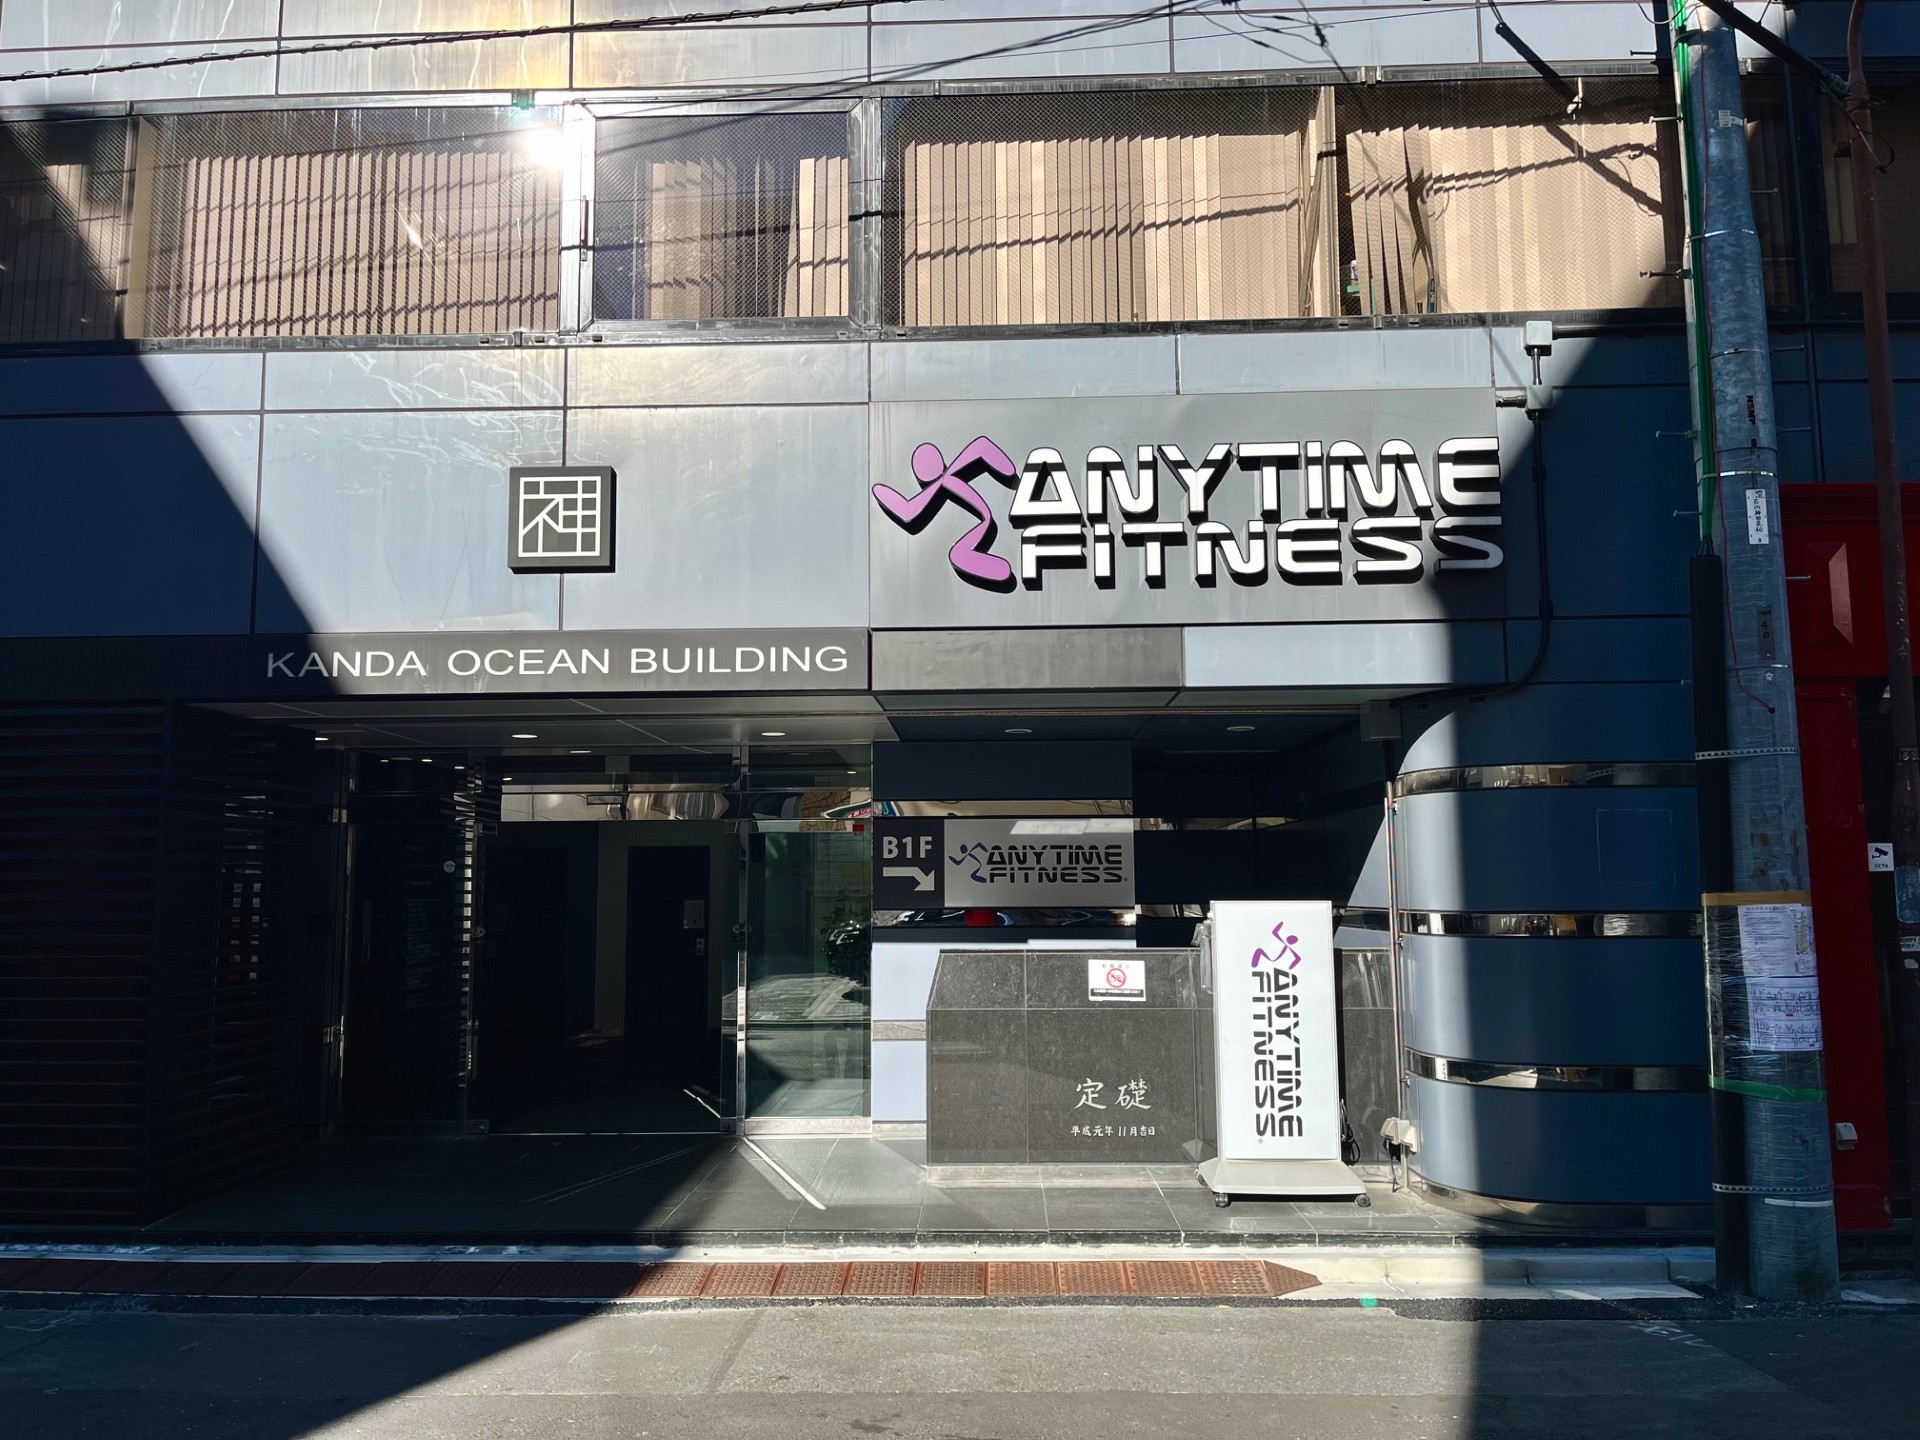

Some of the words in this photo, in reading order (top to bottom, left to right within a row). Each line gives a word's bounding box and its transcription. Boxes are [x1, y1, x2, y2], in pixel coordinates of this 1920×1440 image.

[1009, 437, 1501, 518] ANYTIME
[1021, 516, 1504, 586] FITNESS
[266, 650, 428, 678] KANDA
[447, 648, 610, 676] OCEAN
[630, 646, 849, 674] BUILDING
[882, 836, 933, 859] B1F
[986, 844, 1123, 866] ANYTIME
[1273, 967, 1304, 1138] ANYTIME
[1074, 1077, 1152, 1110] 定礎
